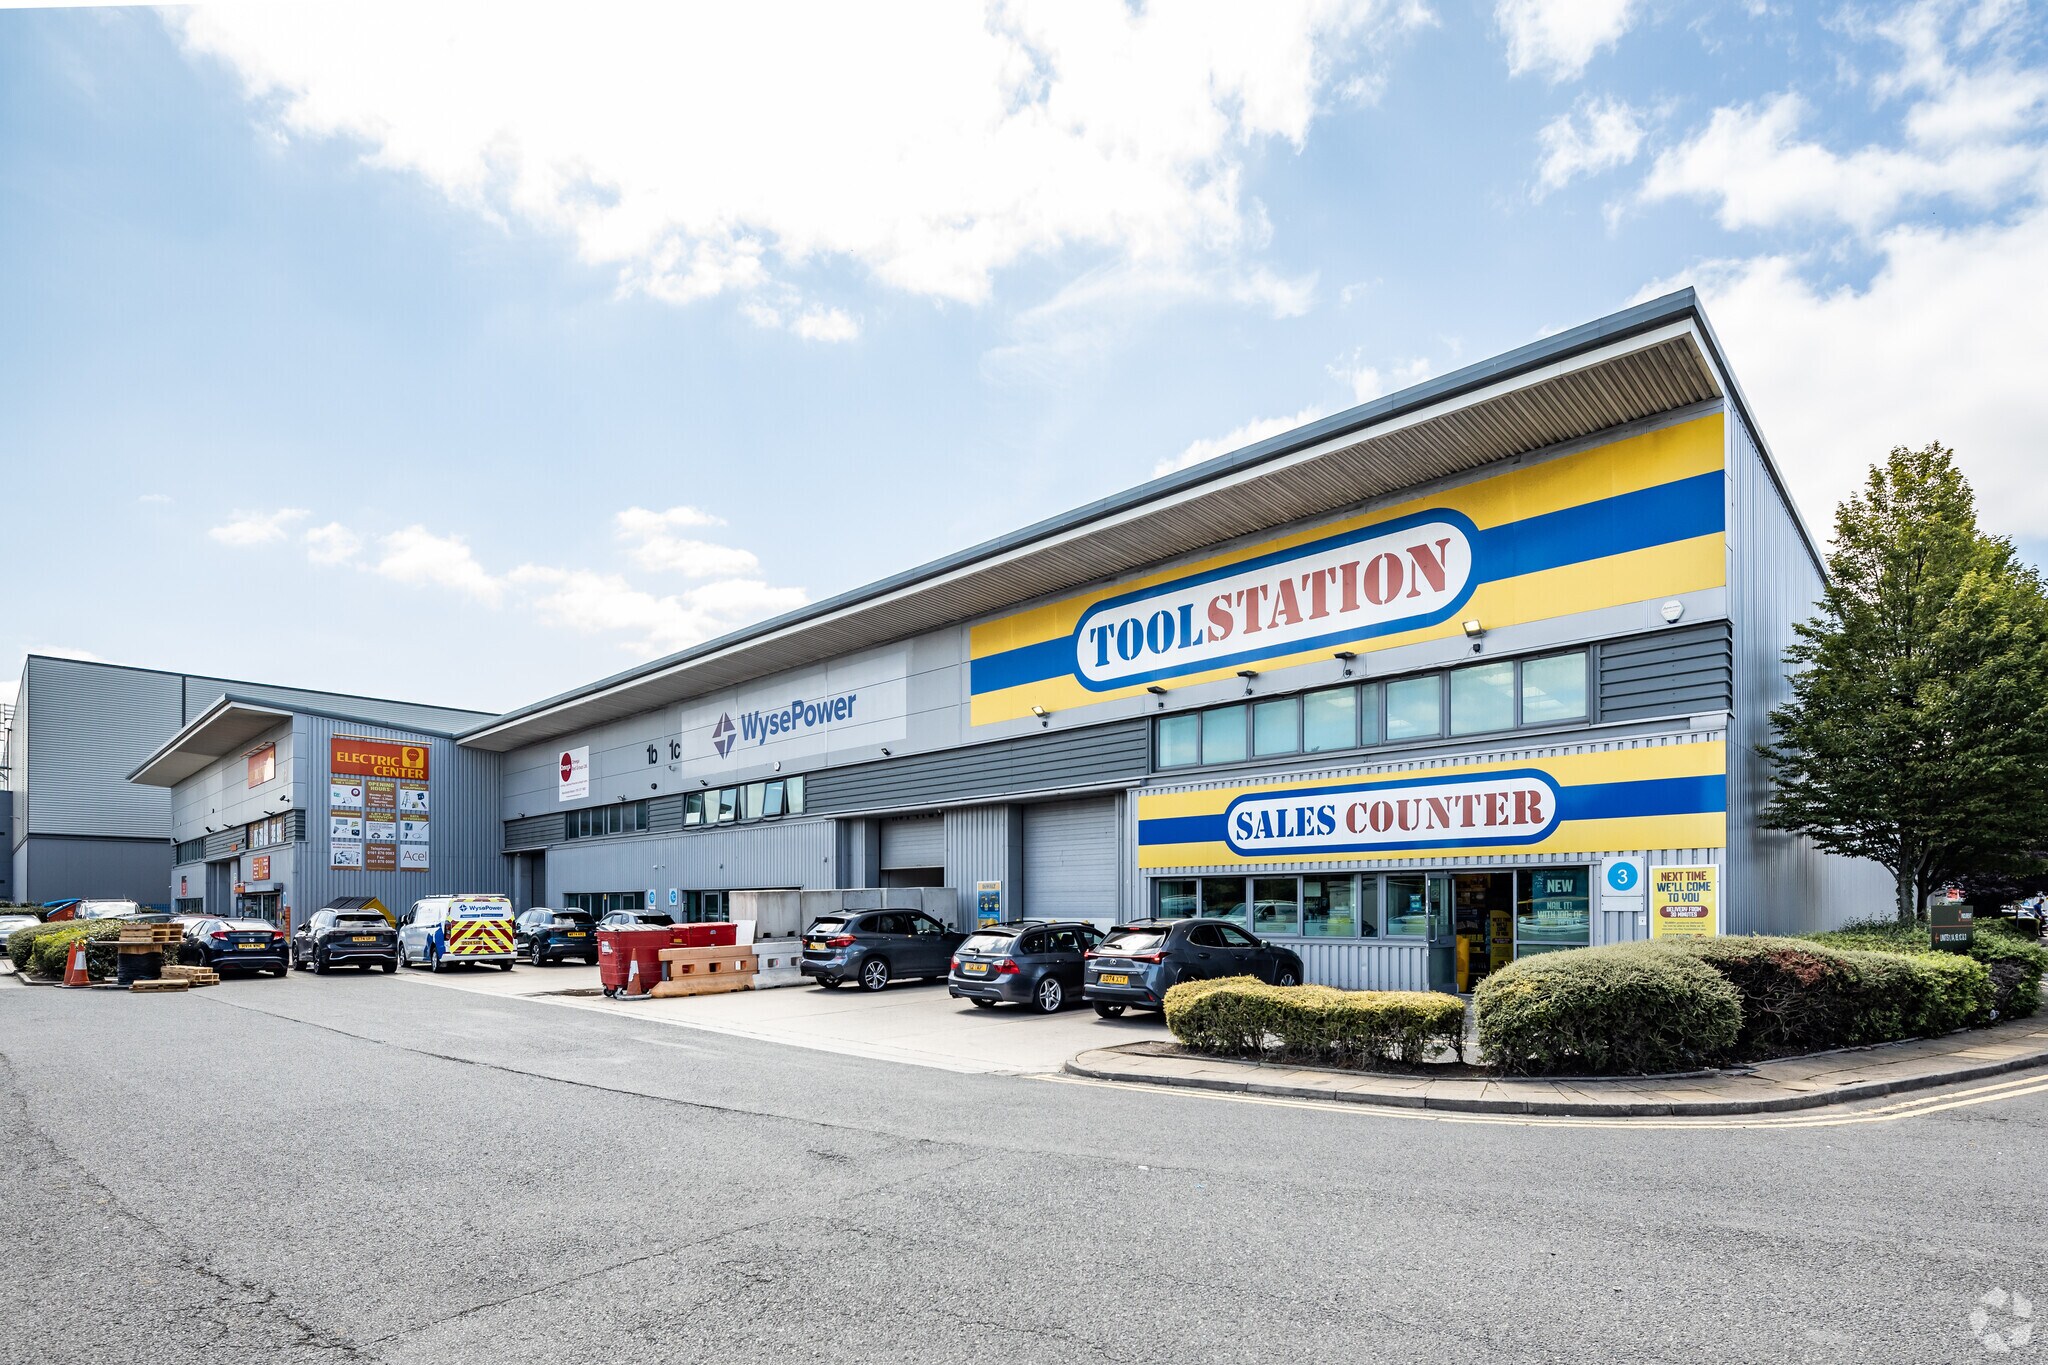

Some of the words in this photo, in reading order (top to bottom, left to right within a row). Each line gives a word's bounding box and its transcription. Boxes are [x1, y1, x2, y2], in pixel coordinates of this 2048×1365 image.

[1090, 537, 1451, 668] TOOLSTATION
[741, 694, 856, 745] WysePower
[647, 745, 657, 764] 1b
[669, 739, 680, 760] 1c
[336, 752, 400, 766] ELECTRIC
[374, 766, 424, 778] CENTER
[1236, 804, 1336, 841] SALES
[1346, 789, 1546, 833] COUNTER
[402, 850, 427, 861] Acel
[1616, 869, 1628, 884] 3
[1661, 872, 1683, 881] NEXT
[1686, 871, 1706, 881] TIME
[1547, 880, 1573, 892] NEW
[1657, 882, 1684, 892] WE'LL
[1687, 882, 1711, 891] COME
[1668, 893, 1679, 902] TO
[1682, 893, 1699, 902] YOU
